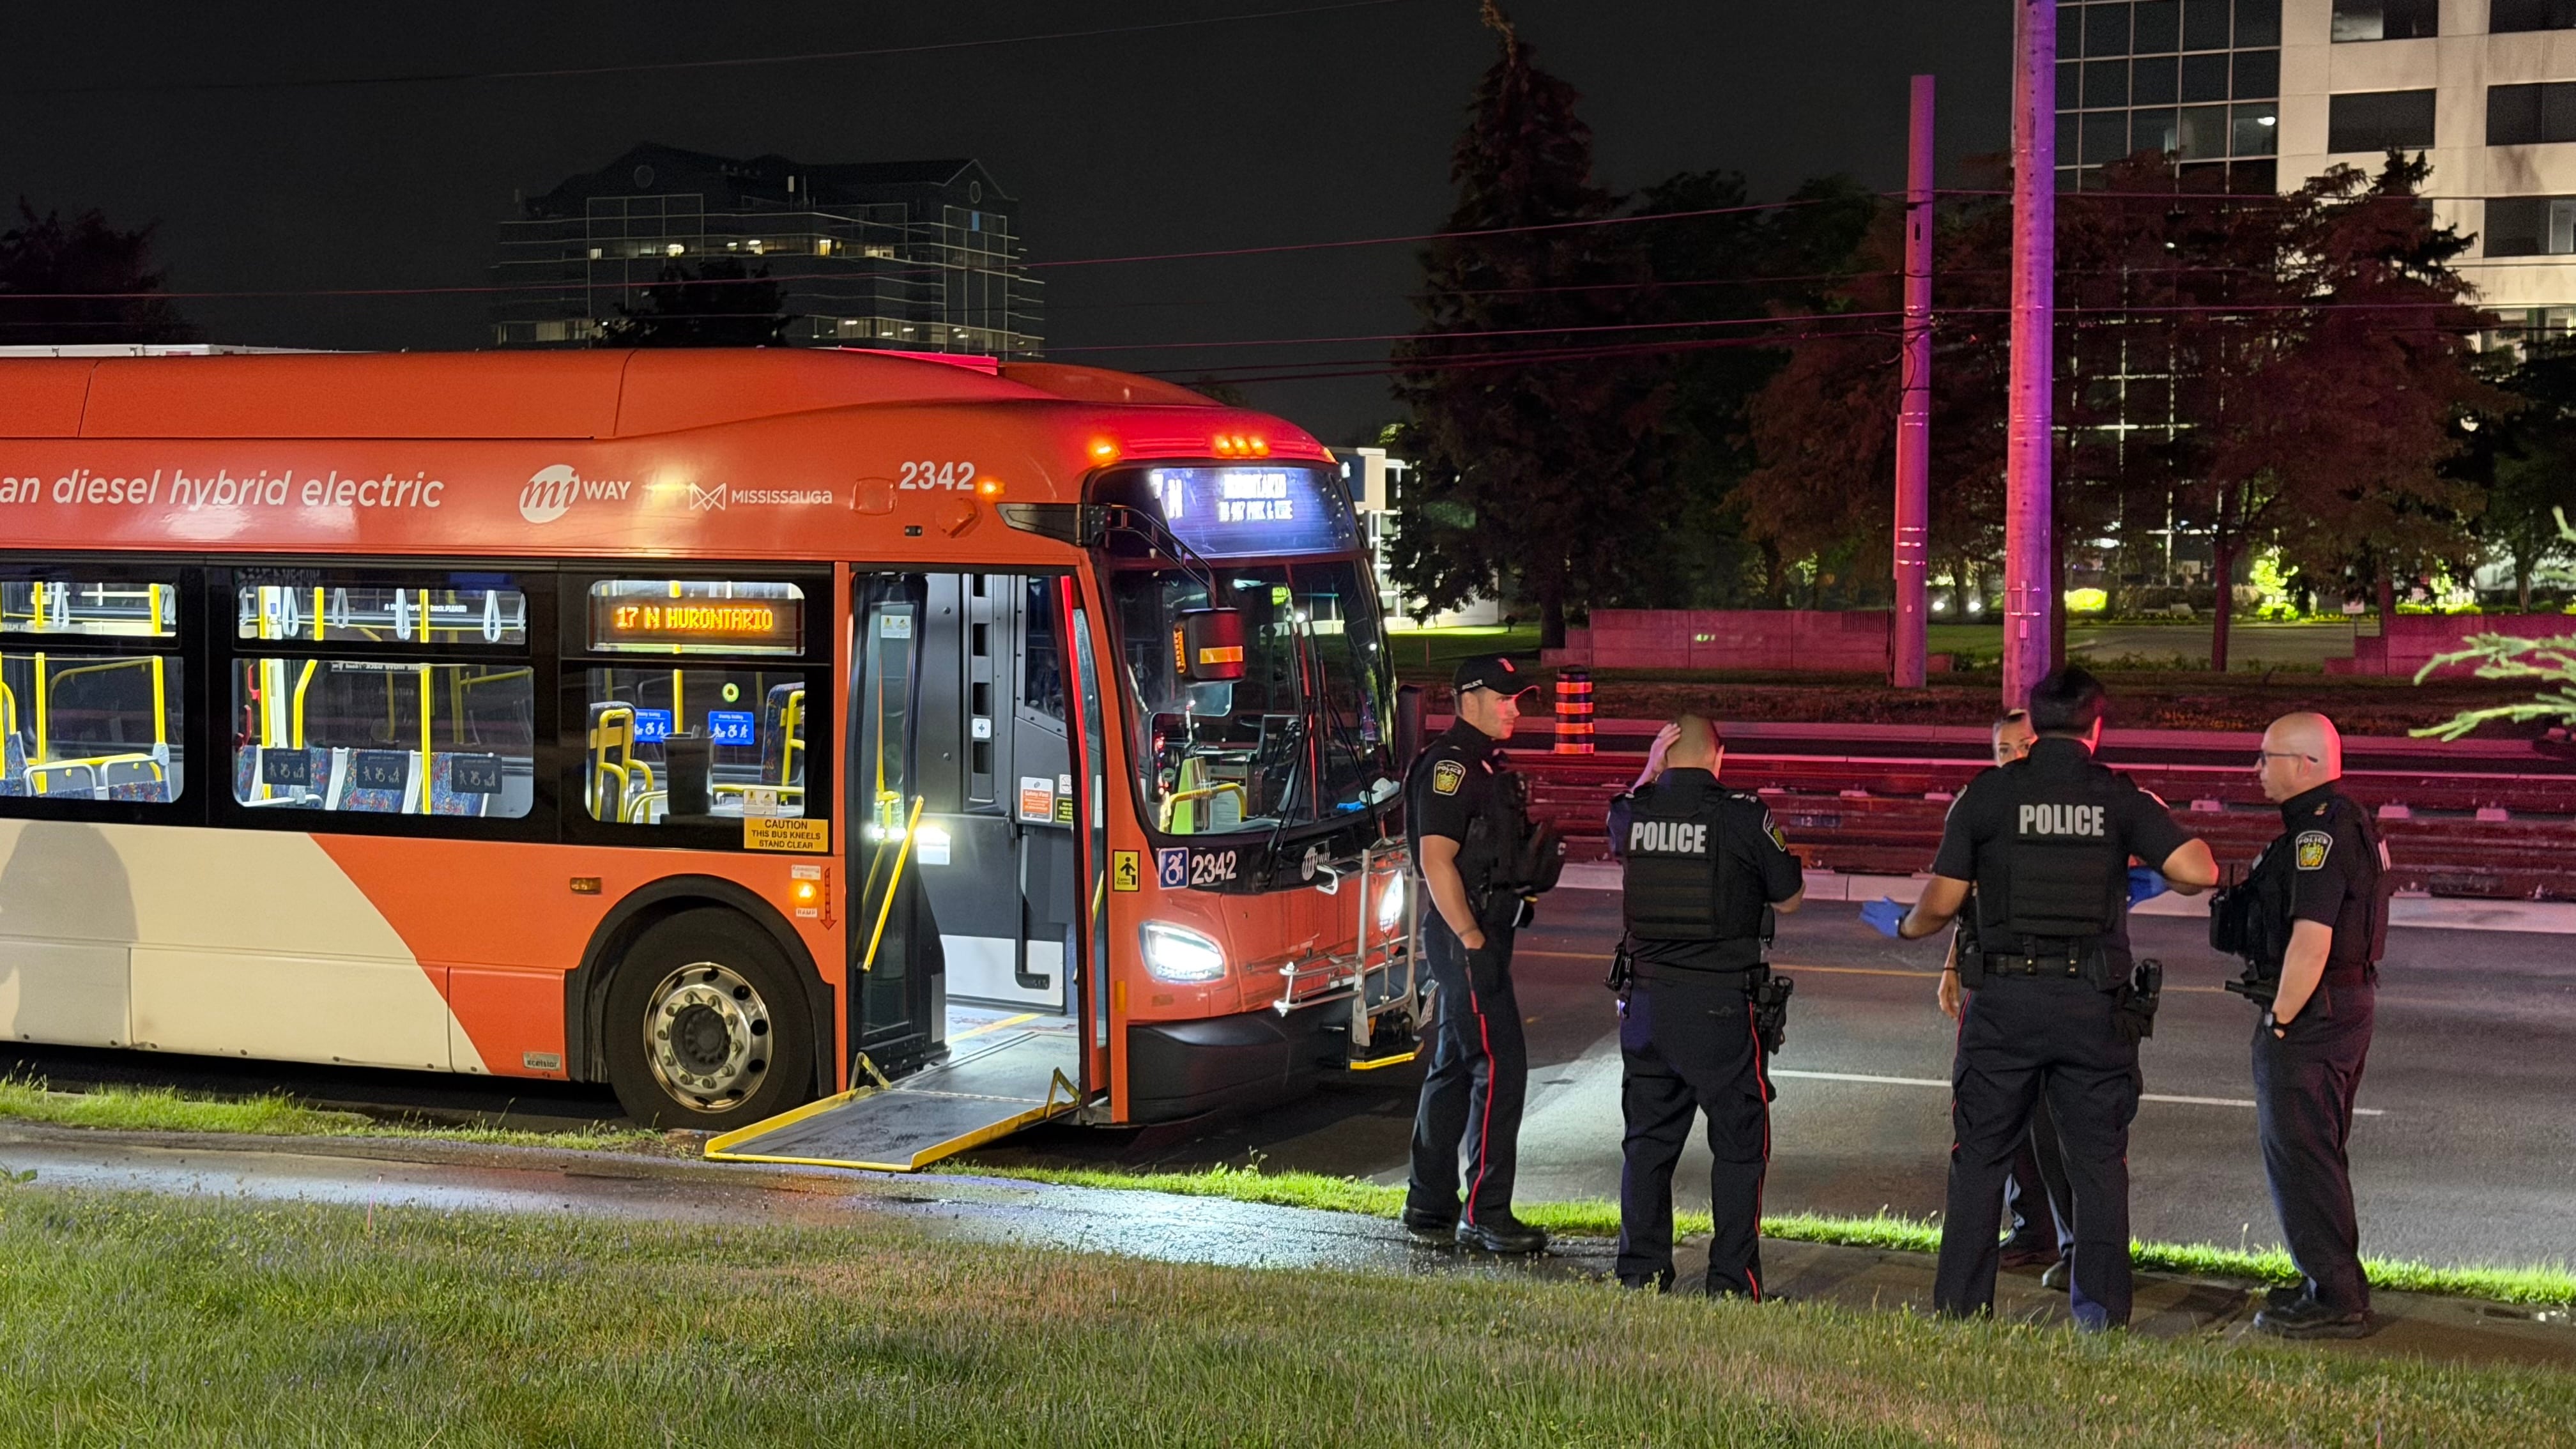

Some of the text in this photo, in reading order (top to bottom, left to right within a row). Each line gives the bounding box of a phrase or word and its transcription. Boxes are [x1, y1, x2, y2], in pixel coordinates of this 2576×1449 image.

[0, 468, 445, 512] an diesel hybrid electric
[583, 480, 631, 500] WAY
[899, 461, 975, 491] 2342
[617, 606, 774, 632] 17 N HURONTARIO
[765, 819, 808, 830] CAUTION
[2020, 803, 2104, 836] POLICE
[751, 829, 821, 840] THIS BUS KNEELS
[759, 839, 813, 849] STAND CLEAR
[1630, 822, 1707, 854] POLICE
[1192, 850, 1237, 885] 2342
